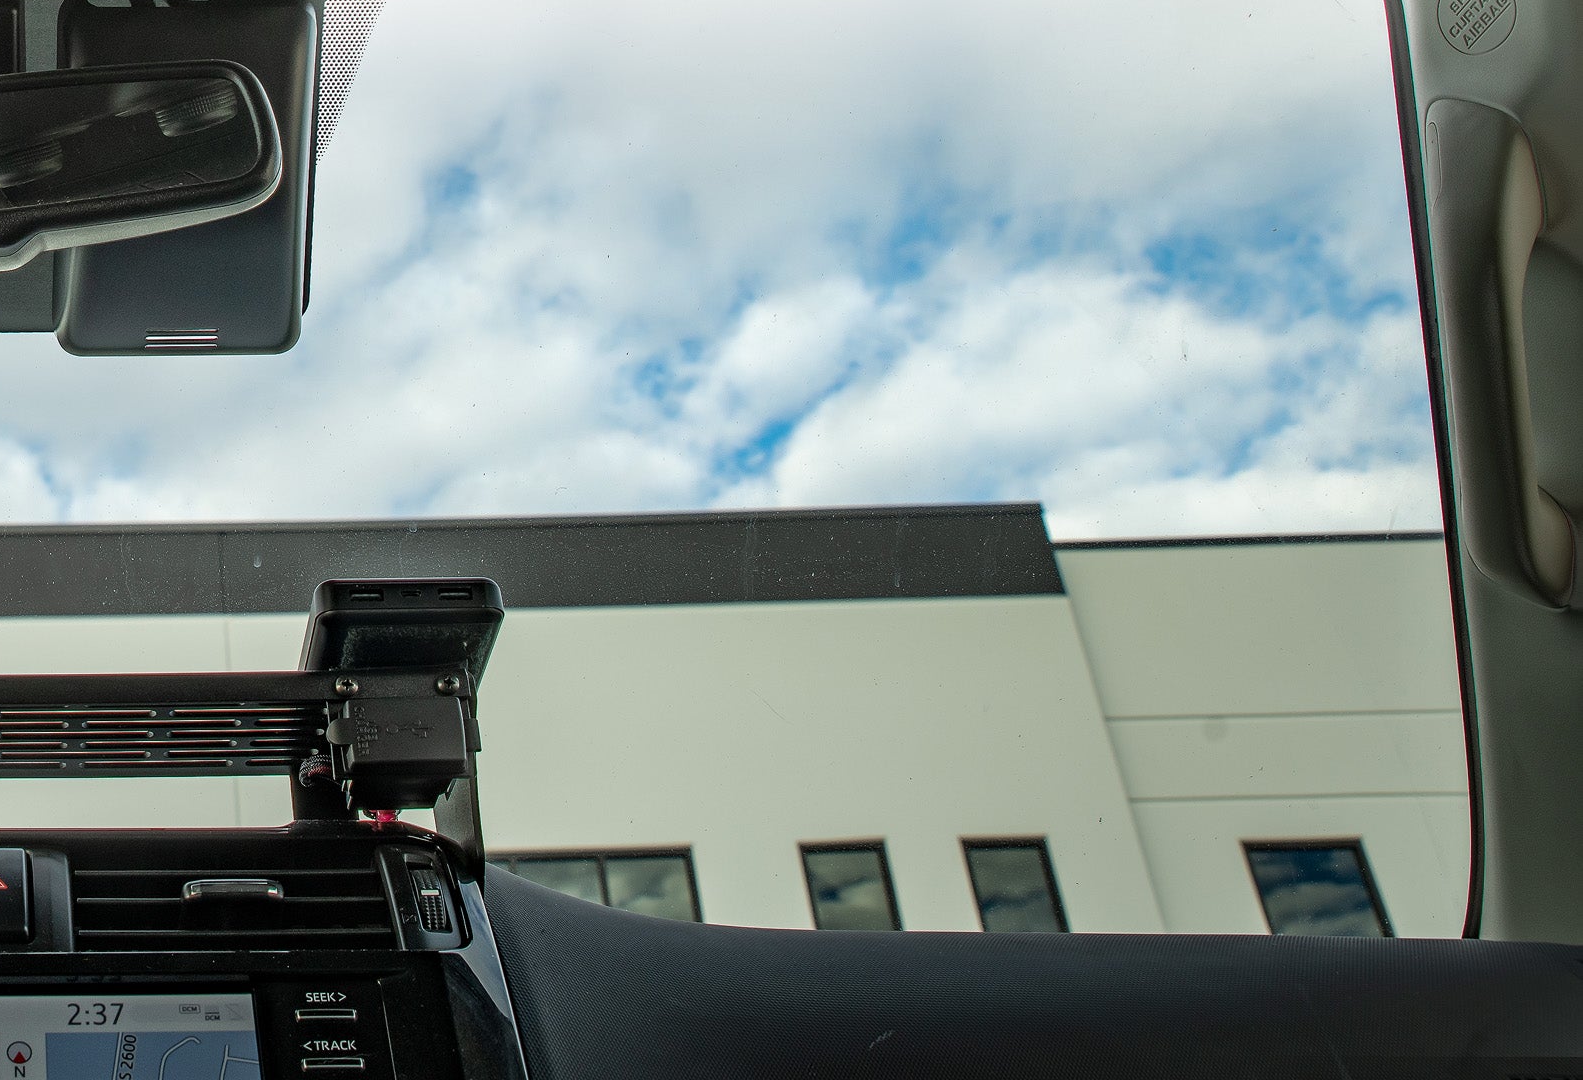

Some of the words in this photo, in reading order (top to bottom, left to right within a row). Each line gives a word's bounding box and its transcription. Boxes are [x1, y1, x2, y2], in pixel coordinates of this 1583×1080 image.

[67, 1002, 124, 1026] 2:37
[181, 1005, 198, 1013] DCM
[205, 1014, 221, 1022] DCM
[120, 1034, 137, 1070] 2600
[14, 1065, 26, 1078] N
